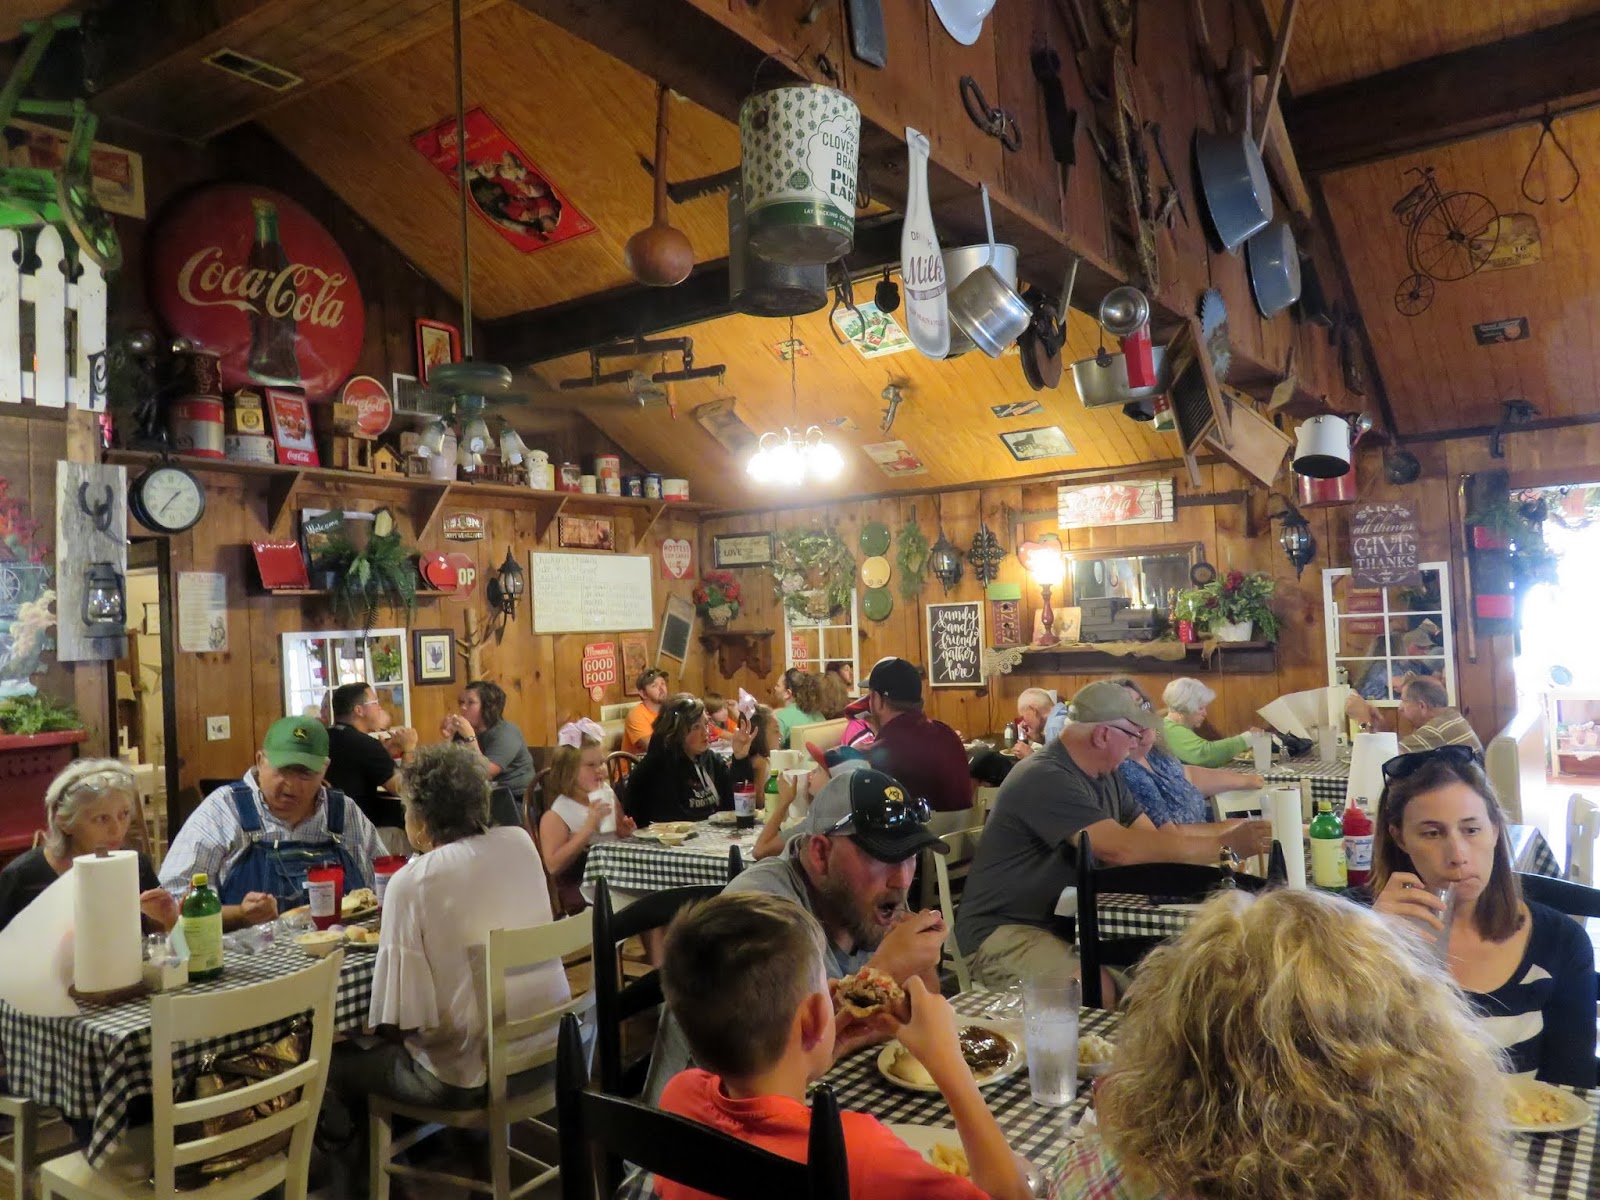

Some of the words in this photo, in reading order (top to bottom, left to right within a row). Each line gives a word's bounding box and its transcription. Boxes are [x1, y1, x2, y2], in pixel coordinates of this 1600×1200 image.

[836, 152, 856, 175] BRAN
[831, 169, 855, 192] PUR
[830, 183, 855, 206] LAR
[816, 210, 839, 219] ACKING
[905, 255, 944, 285] Milk
[178, 247, 348, 328] Coca-Cola
[663, 544, 690, 553] HOSTESS
[724, 548, 743, 557] LOVE
[1353, 534, 1416, 558] GIVE
[1356, 555, 1415, 570] THANKS
[933, 606, 979, 631] family
[935, 627, 979, 649] friends
[585, 658, 613, 672] GOOD
[933, 645, 977, 665] gather
[585, 670, 614, 684] FOOD
[940, 660, 975, 680] here
